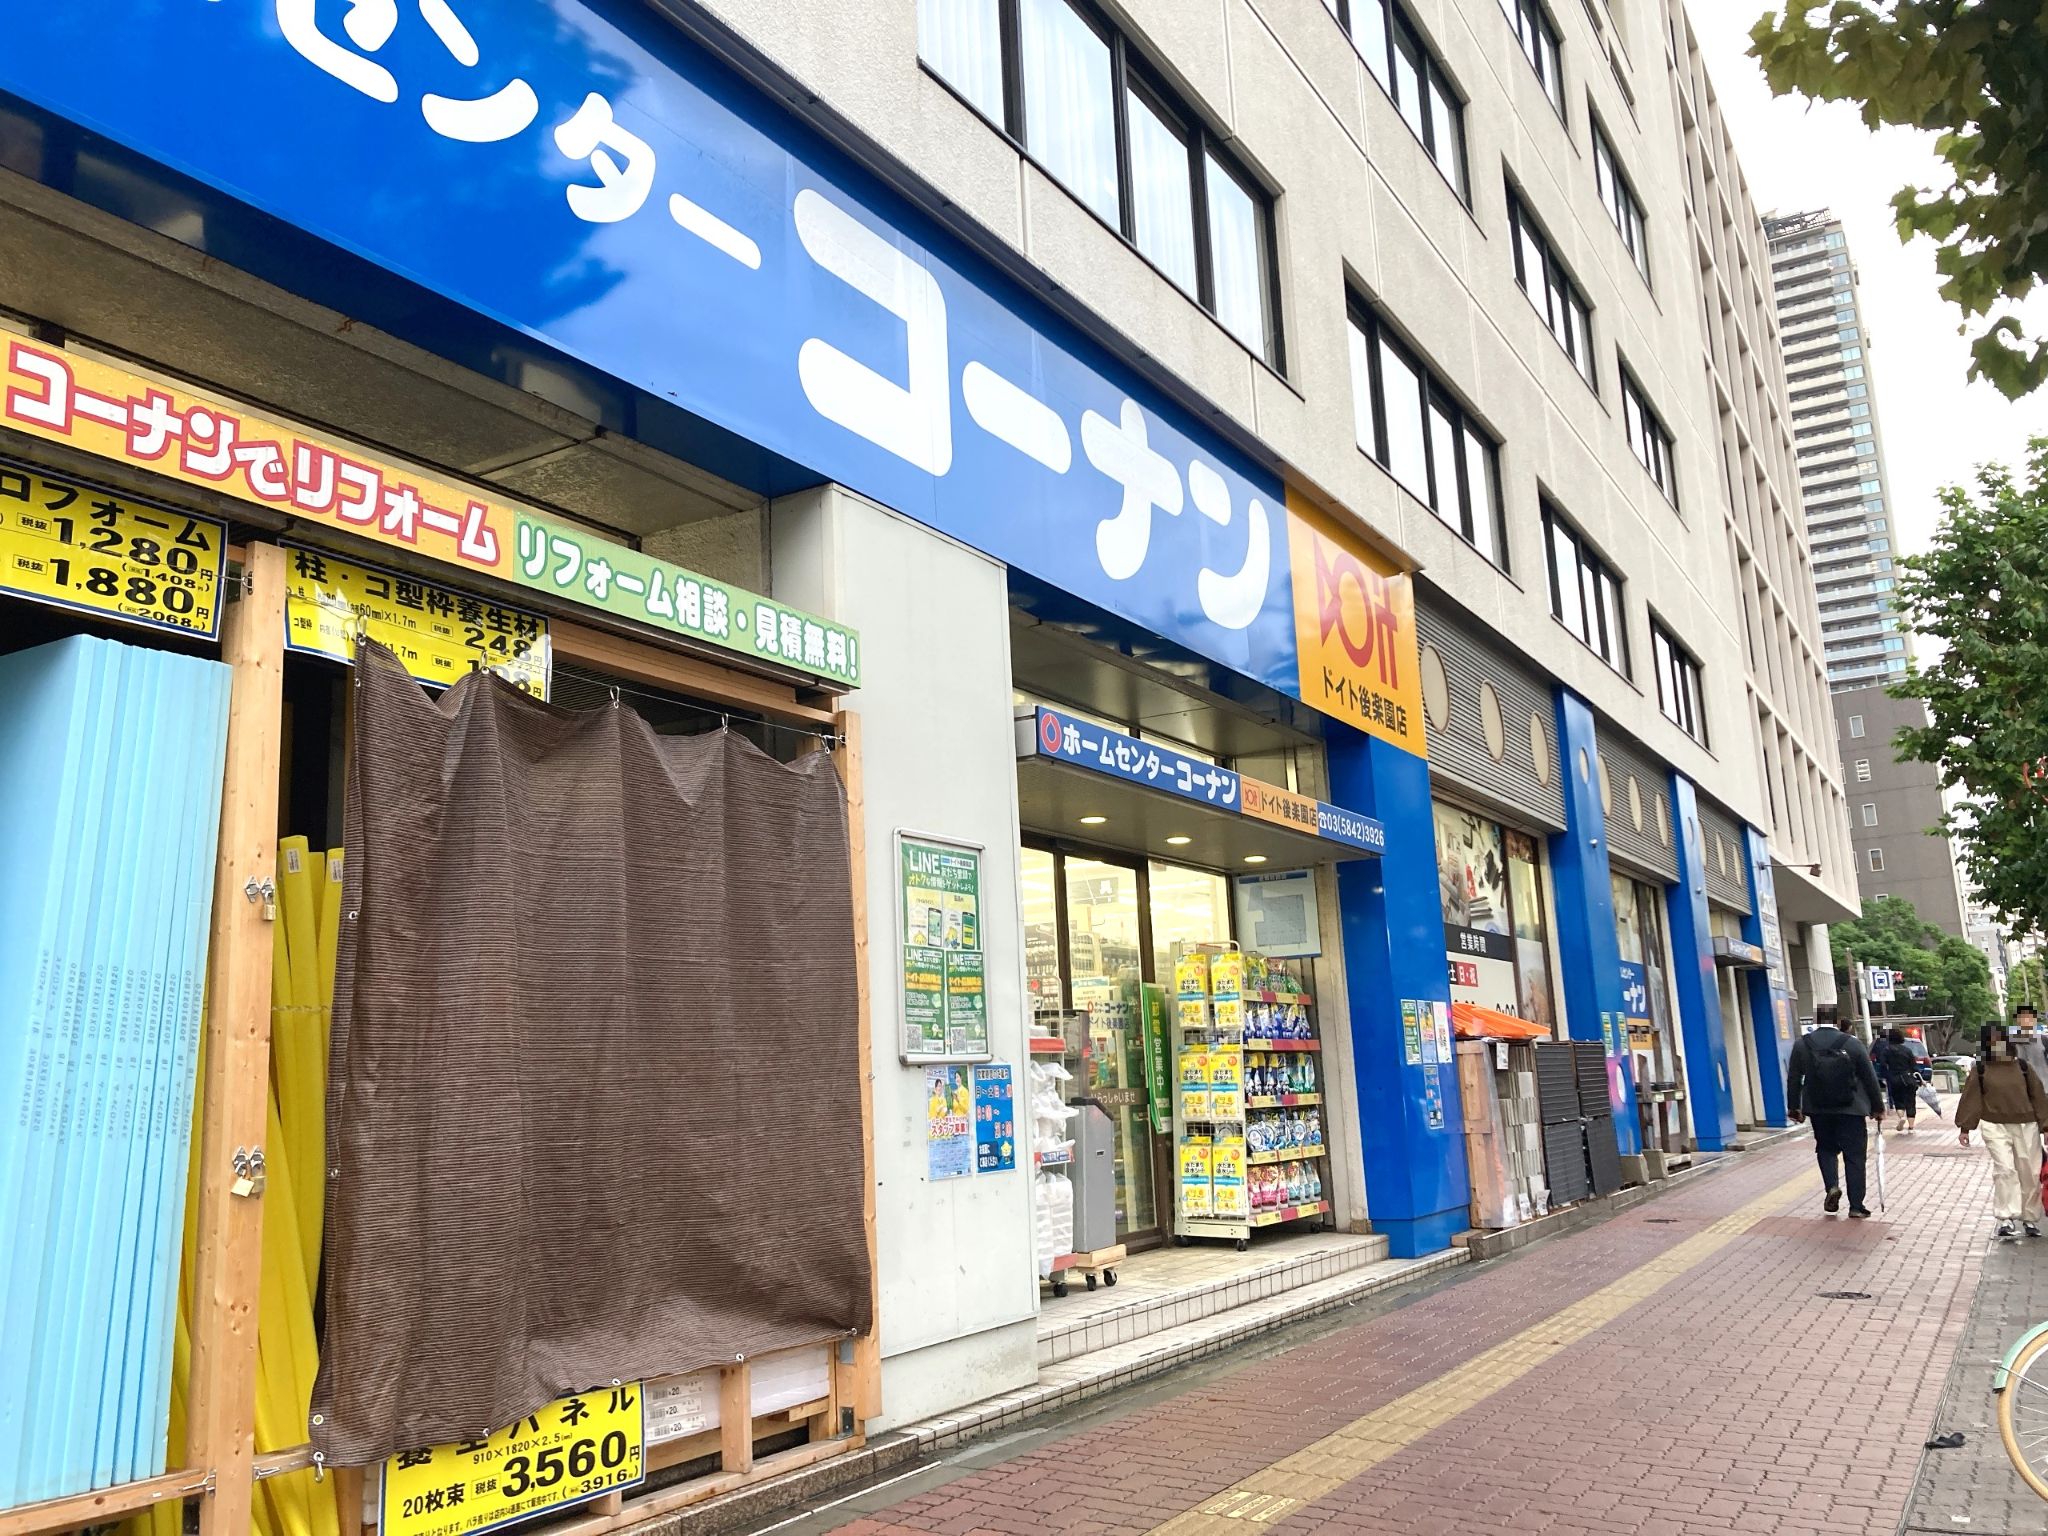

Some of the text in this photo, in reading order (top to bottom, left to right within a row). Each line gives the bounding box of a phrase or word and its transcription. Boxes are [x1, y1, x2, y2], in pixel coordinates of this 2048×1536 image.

[7, 341, 500, 567] コーナンでリフォーム
[21, 517, 47, 531] 税抜
[17, 559, 45, 574] 税抜
[295, 552, 539, 642] 柱・コ型枠養生材
[1323, 665, 1408, 738] ドイト後楽園店
[1261, 791, 1317, 827] ドイト後楽園店
[1327, 816, 1385, 847] 03(5842)3926
[909, 849, 940, 875] LINE
[906, 948, 923, 961] LINE
[1105, 1001, 1129, 1014] コーナン
[403, 1482, 466, 1518] 20枚束
[475, 1479, 497, 1495] 税抜
